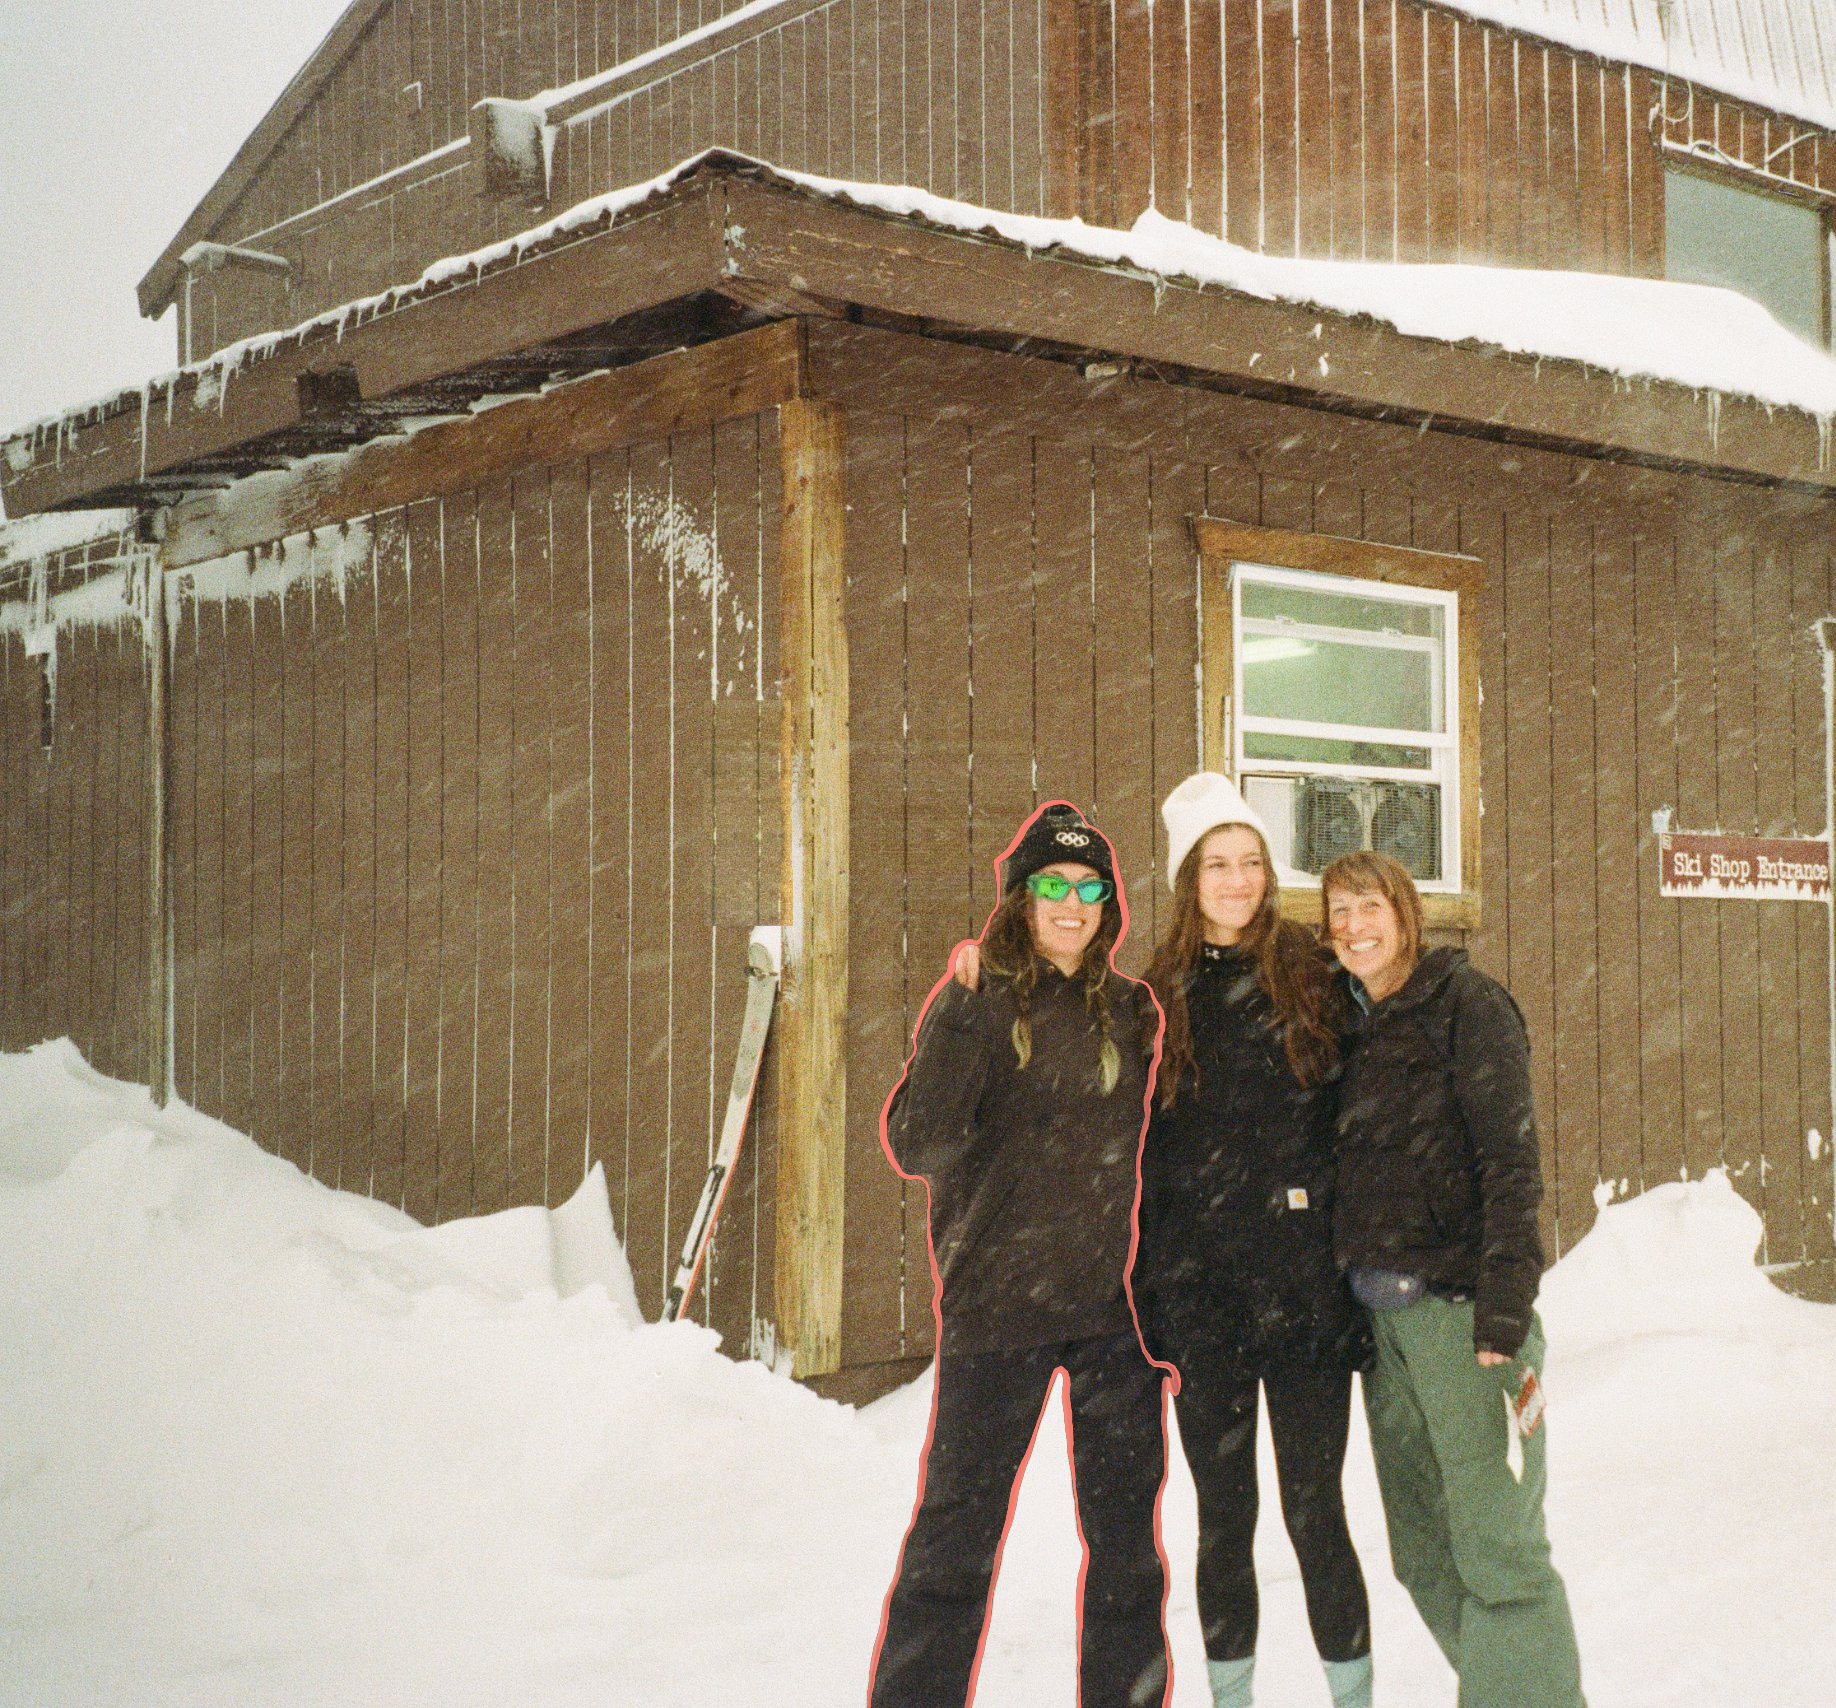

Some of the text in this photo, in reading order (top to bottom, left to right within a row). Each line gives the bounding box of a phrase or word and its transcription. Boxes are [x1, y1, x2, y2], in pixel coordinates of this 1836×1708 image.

[1673, 852, 1828, 883] Ski Shop Entrance
